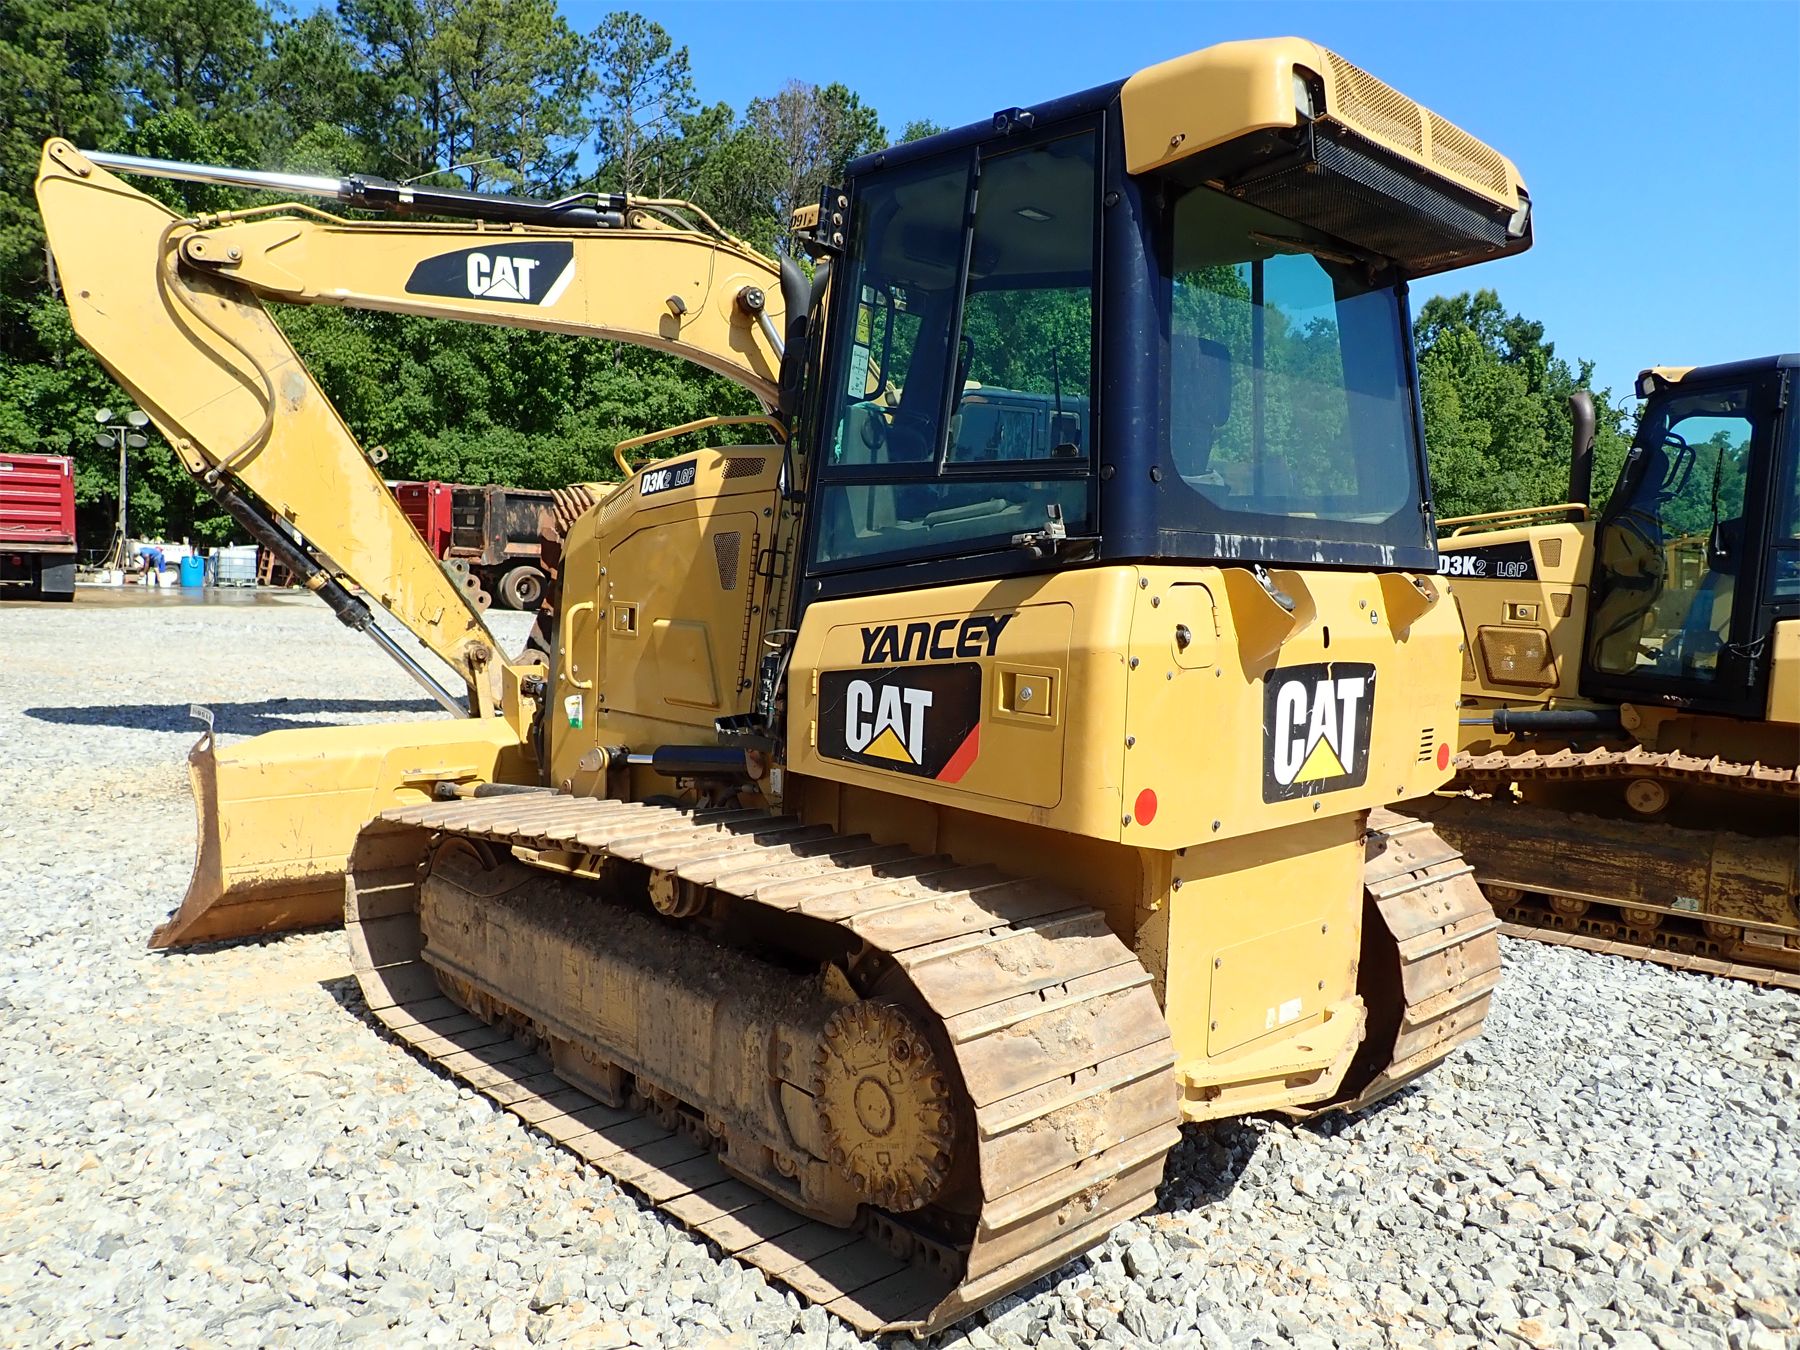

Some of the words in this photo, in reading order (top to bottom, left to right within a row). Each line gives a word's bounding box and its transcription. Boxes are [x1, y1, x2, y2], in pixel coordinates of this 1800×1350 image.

[467, 252, 536, 300] CAT
[674, 467, 695, 487] LGP
[1496, 561, 1528, 577] LGP
[860, 613, 1014, 664] YANCEY
[845, 679, 933, 765] CAT
[1273, 677, 1365, 785] CAT
